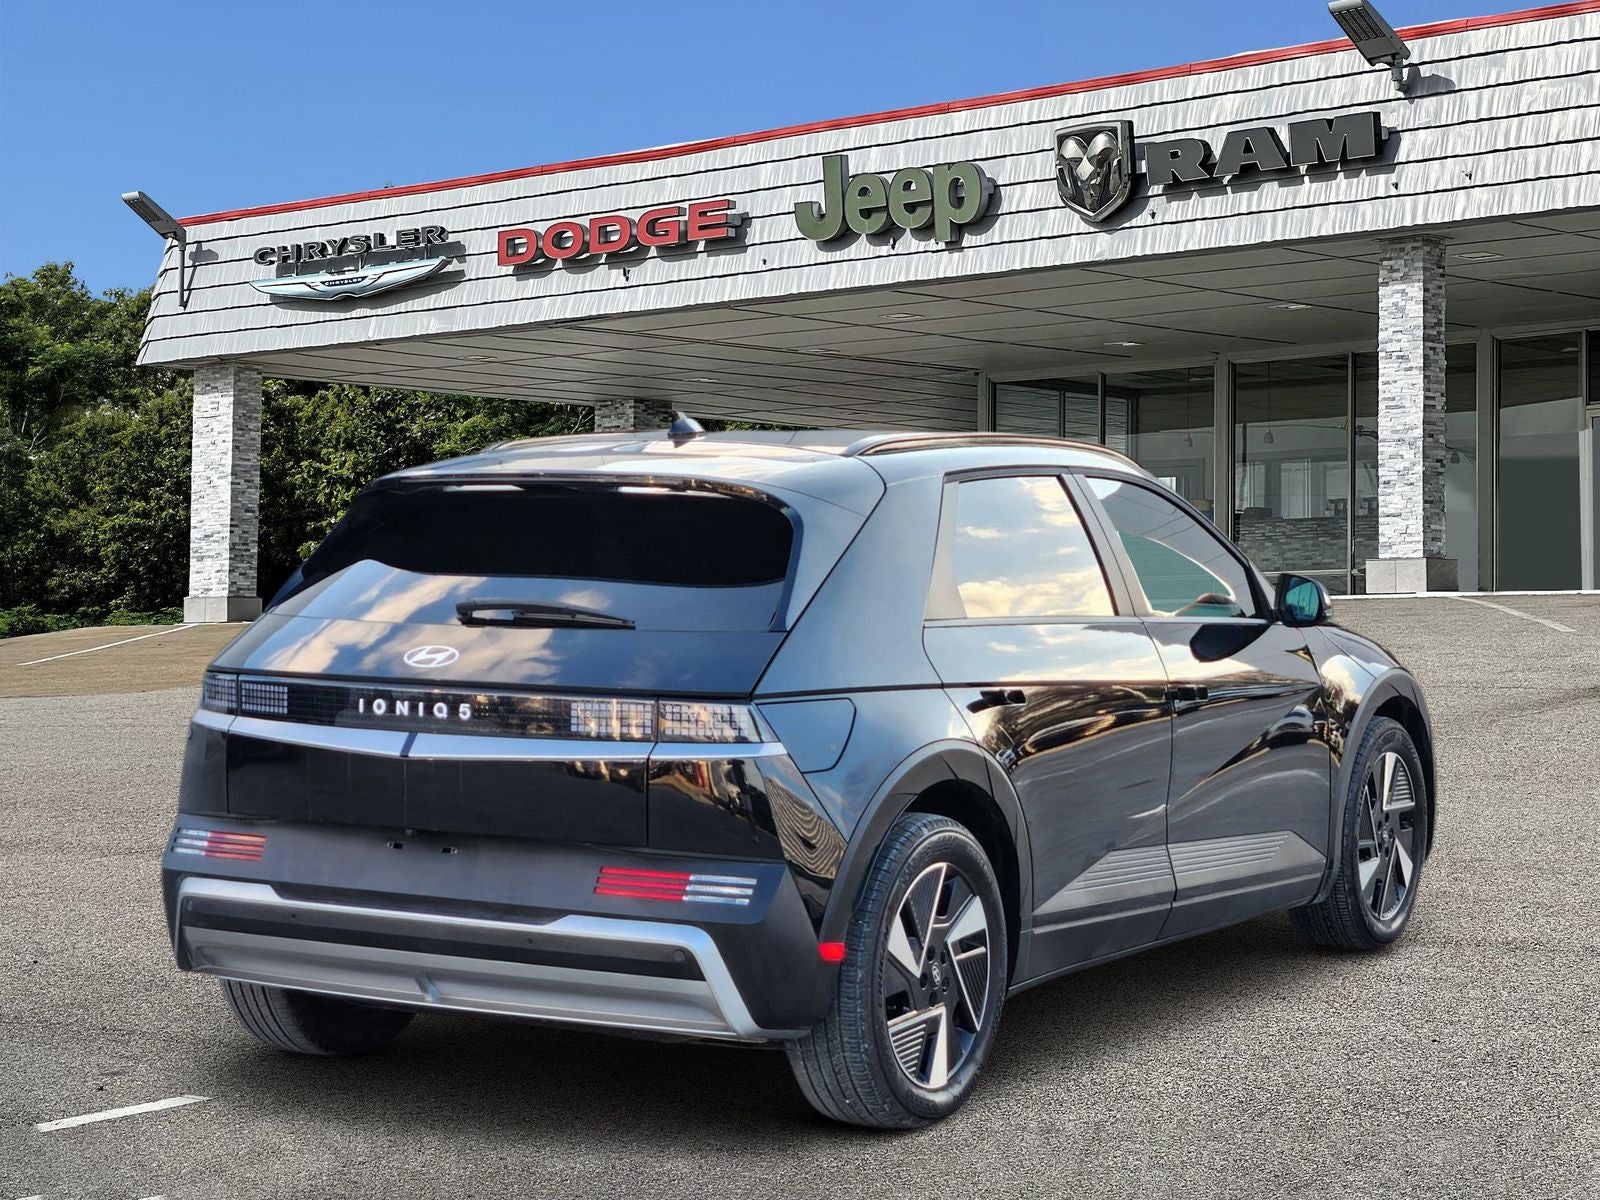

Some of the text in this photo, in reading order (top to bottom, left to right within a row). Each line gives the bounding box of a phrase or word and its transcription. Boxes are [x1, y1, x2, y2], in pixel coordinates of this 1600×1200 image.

[1144, 111, 1380, 187] RAM
[497, 199, 734, 266] DODGE
[794, 153, 986, 243] Jeep
[253, 225, 449, 266] CHRYSLER
